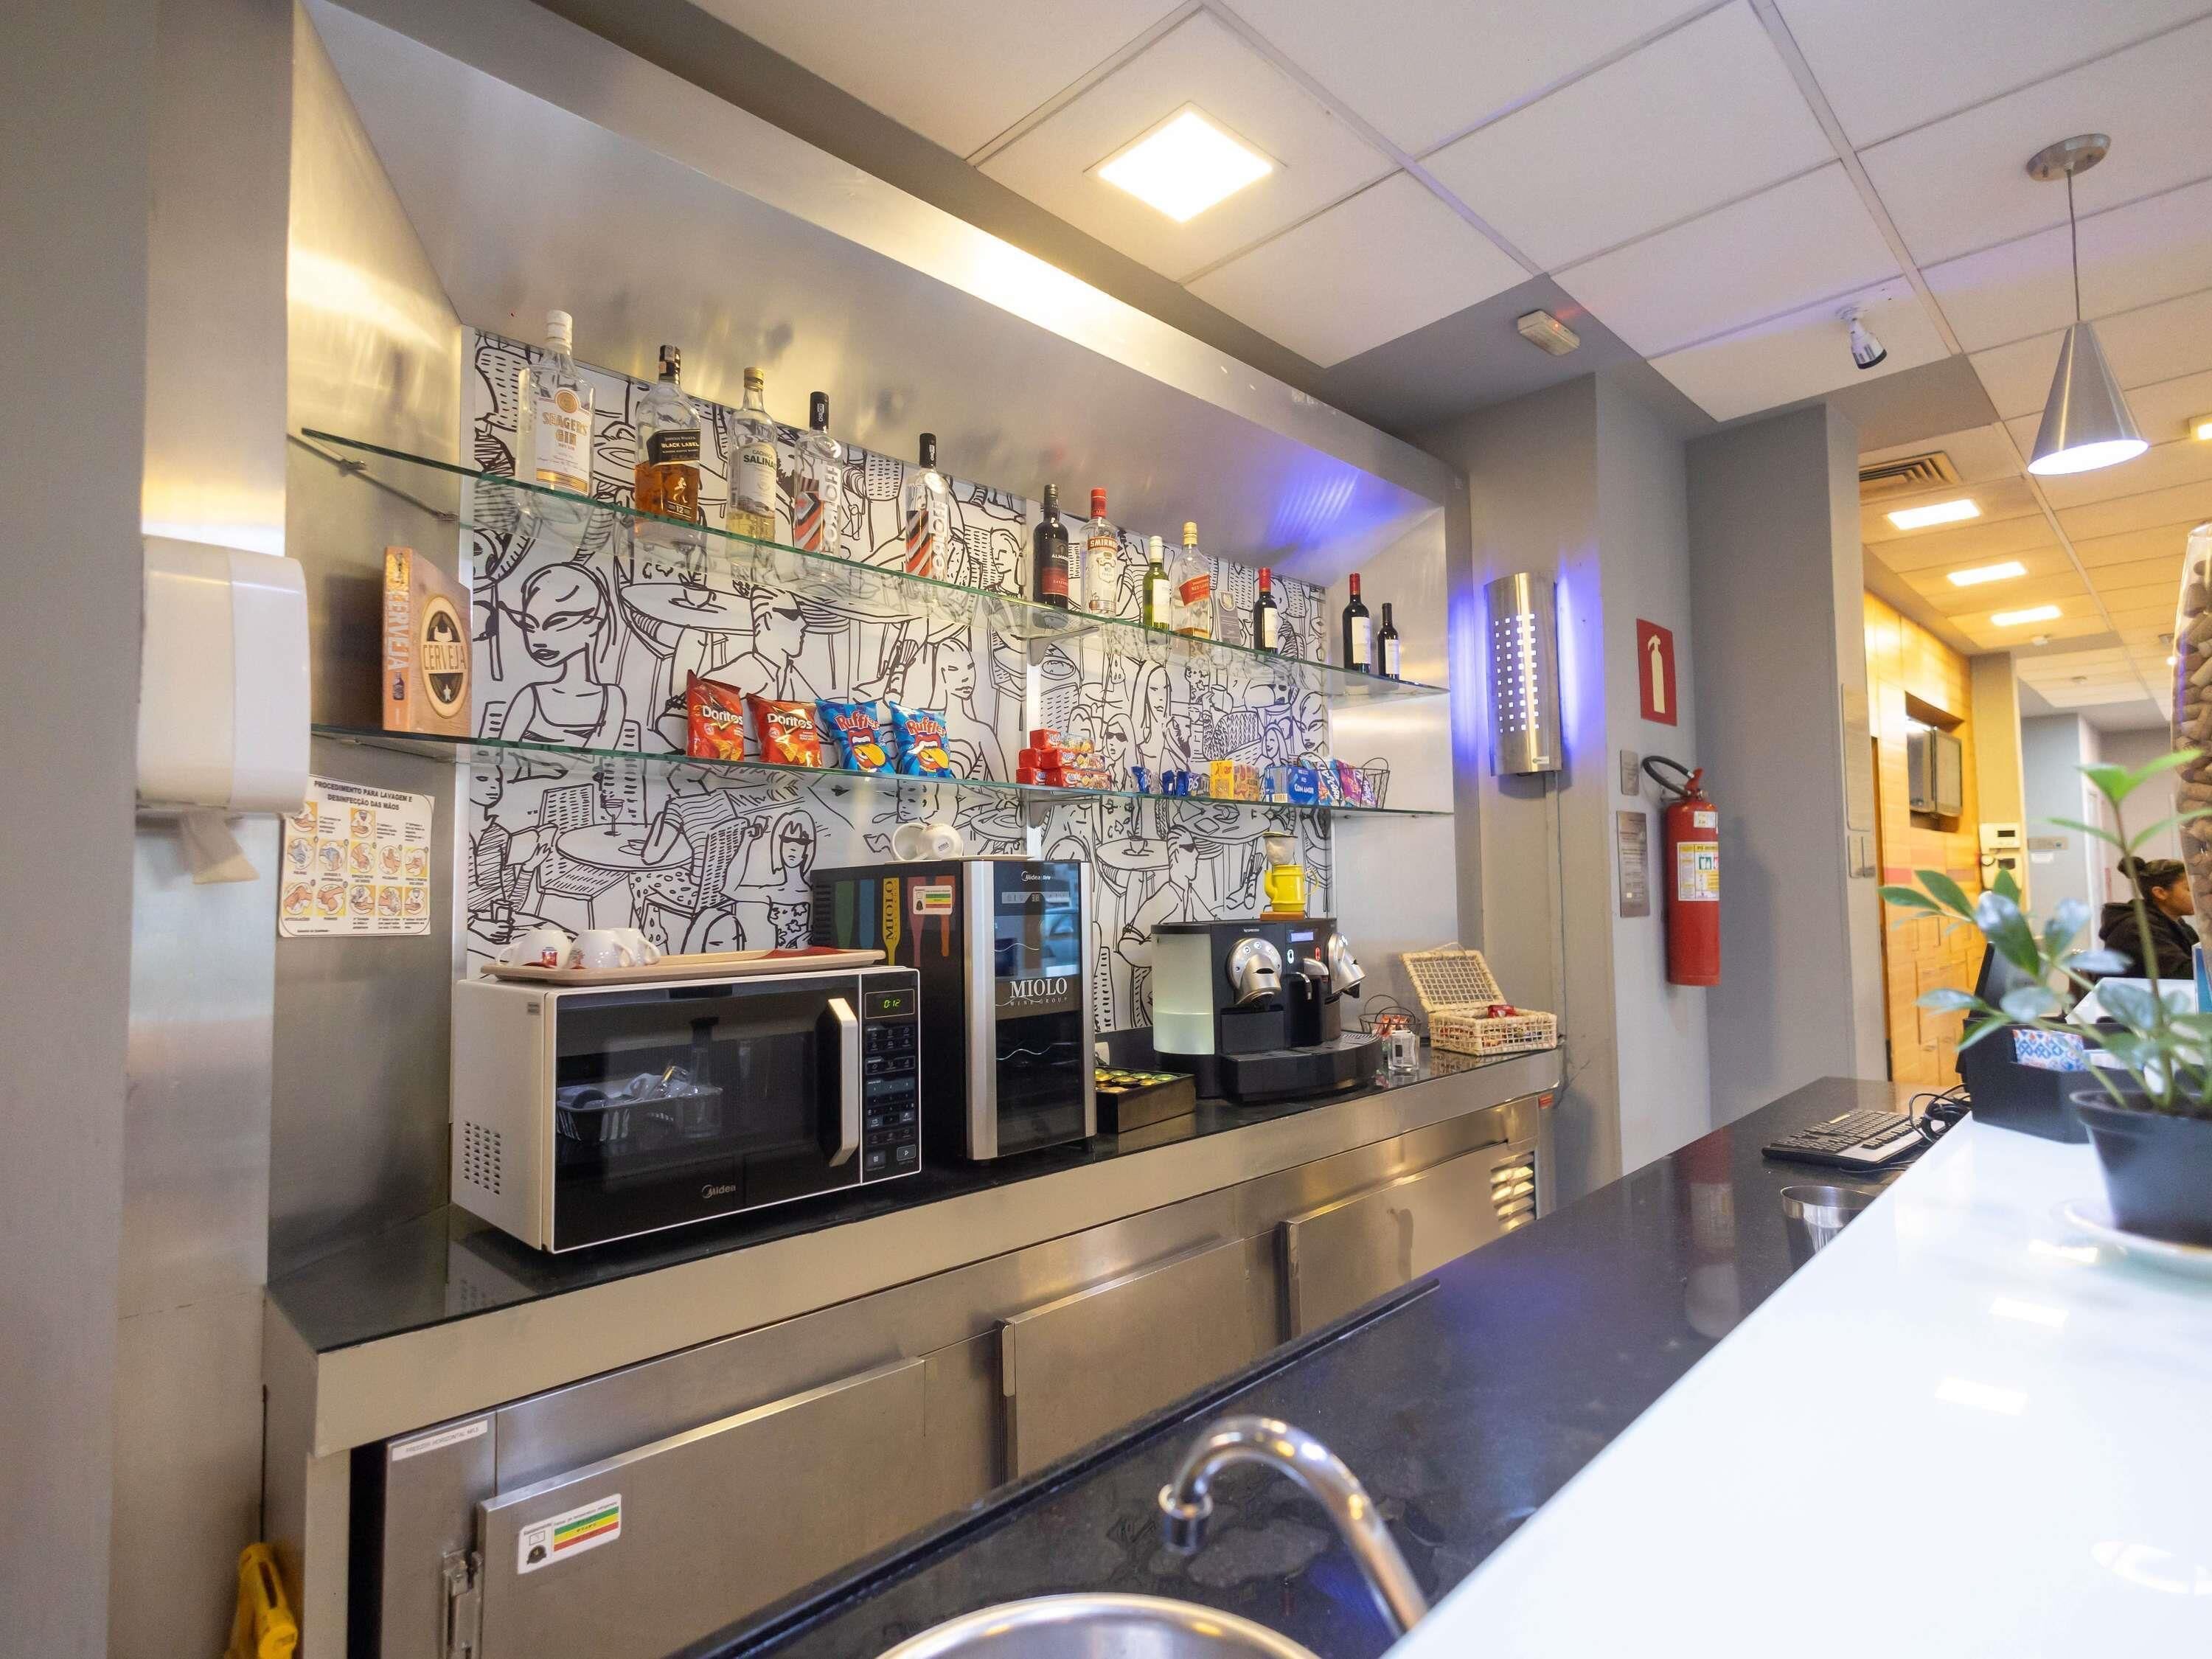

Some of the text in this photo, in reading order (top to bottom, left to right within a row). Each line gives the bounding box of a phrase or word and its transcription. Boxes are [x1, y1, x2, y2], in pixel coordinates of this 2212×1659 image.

[556, 429, 577, 446] GIN
[675, 505, 684, 514] 12
[1090, 540, 1117, 548] SMIRNO
[388, 590, 408, 670] CERVEJA
[423, 644, 467, 670] CERVEJA
[702, 705, 743, 725] Doritos
[767, 713, 813, 729] Doritos
[834, 710, 880, 731] Ruffles
[905, 717, 947, 737] Ruffles
[314, 780, 361, 794] PROCEDIMENTO
[363, 788, 378, 797] PARA
[380, 790, 407, 801] LAVAGEM
[327, 794, 369, 807] DESINFECÇÃO
[1023, 872, 1040, 881] Midea
[1009, 977, 1068, 998] MIOLO
[706, 1185, 736, 1197] Midea
